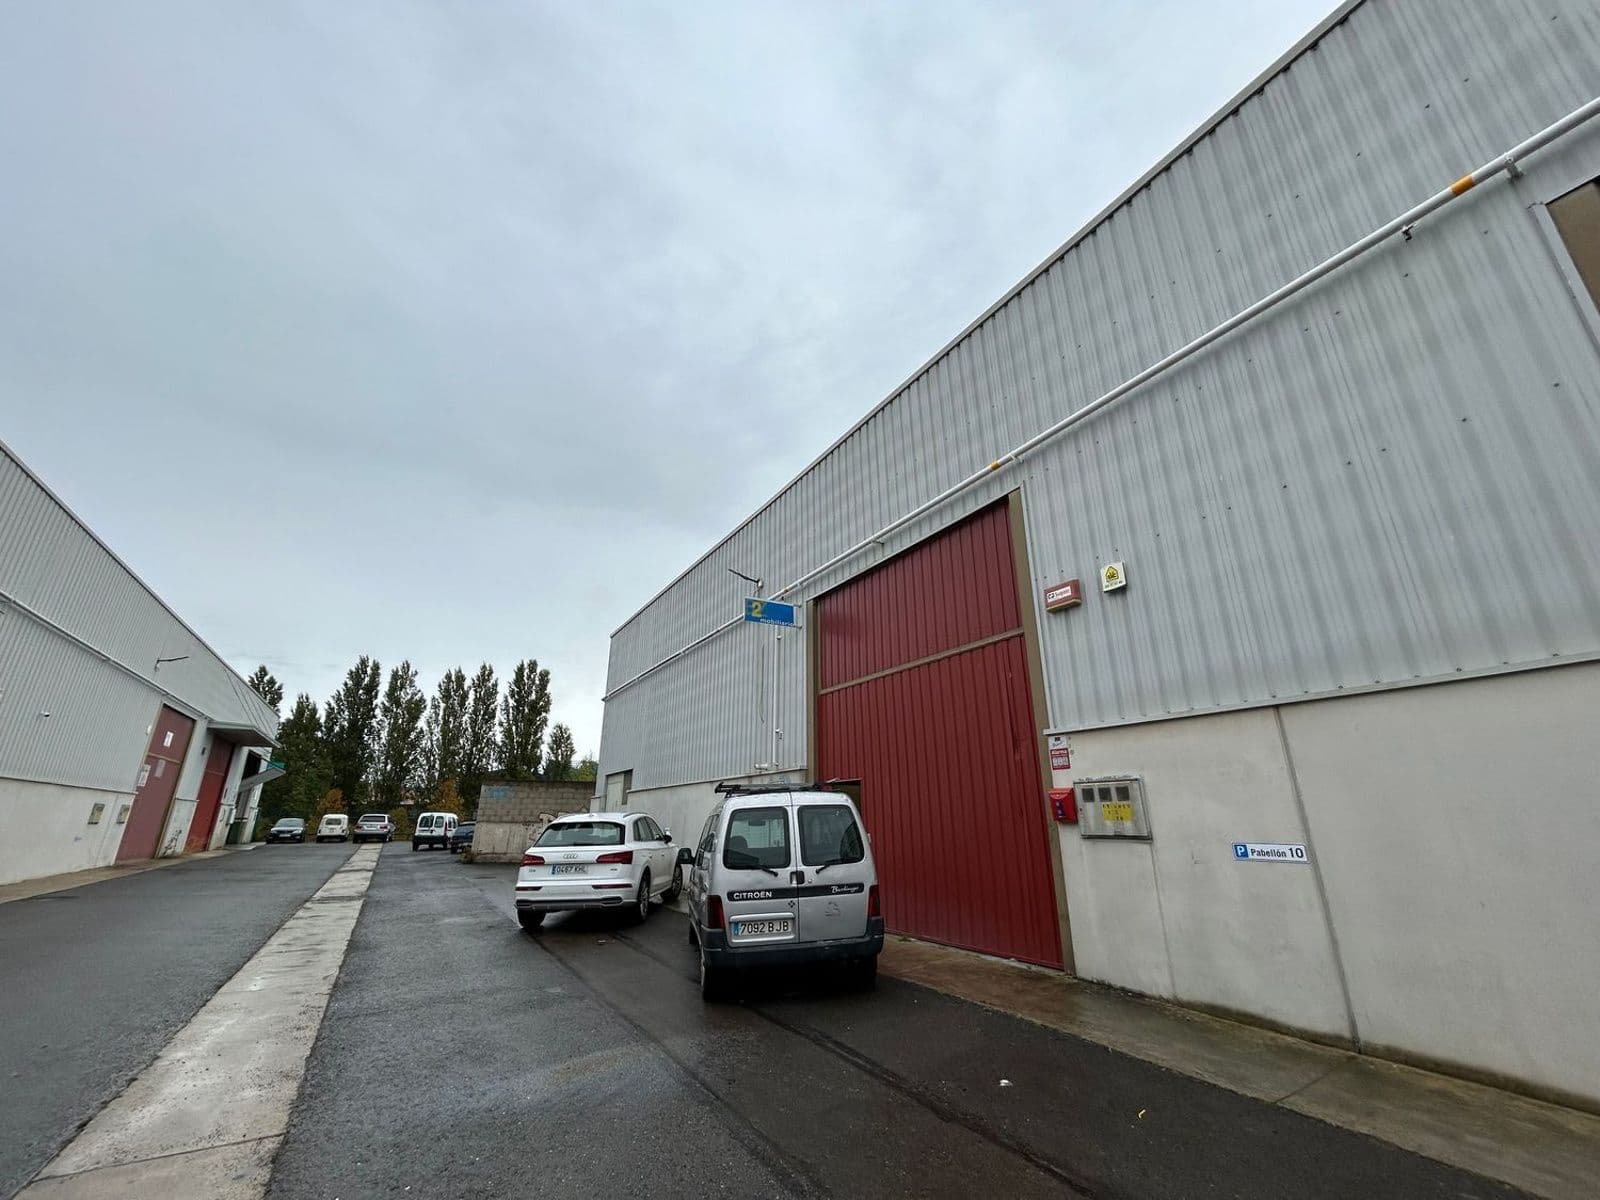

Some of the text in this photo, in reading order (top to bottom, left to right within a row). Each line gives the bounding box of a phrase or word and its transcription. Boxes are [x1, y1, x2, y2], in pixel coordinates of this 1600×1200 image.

[1250, 848, 1287, 858] Pabellón
[1288, 847, 1304, 859] 10
[740, 921, 789, 935] 7092 BJB
